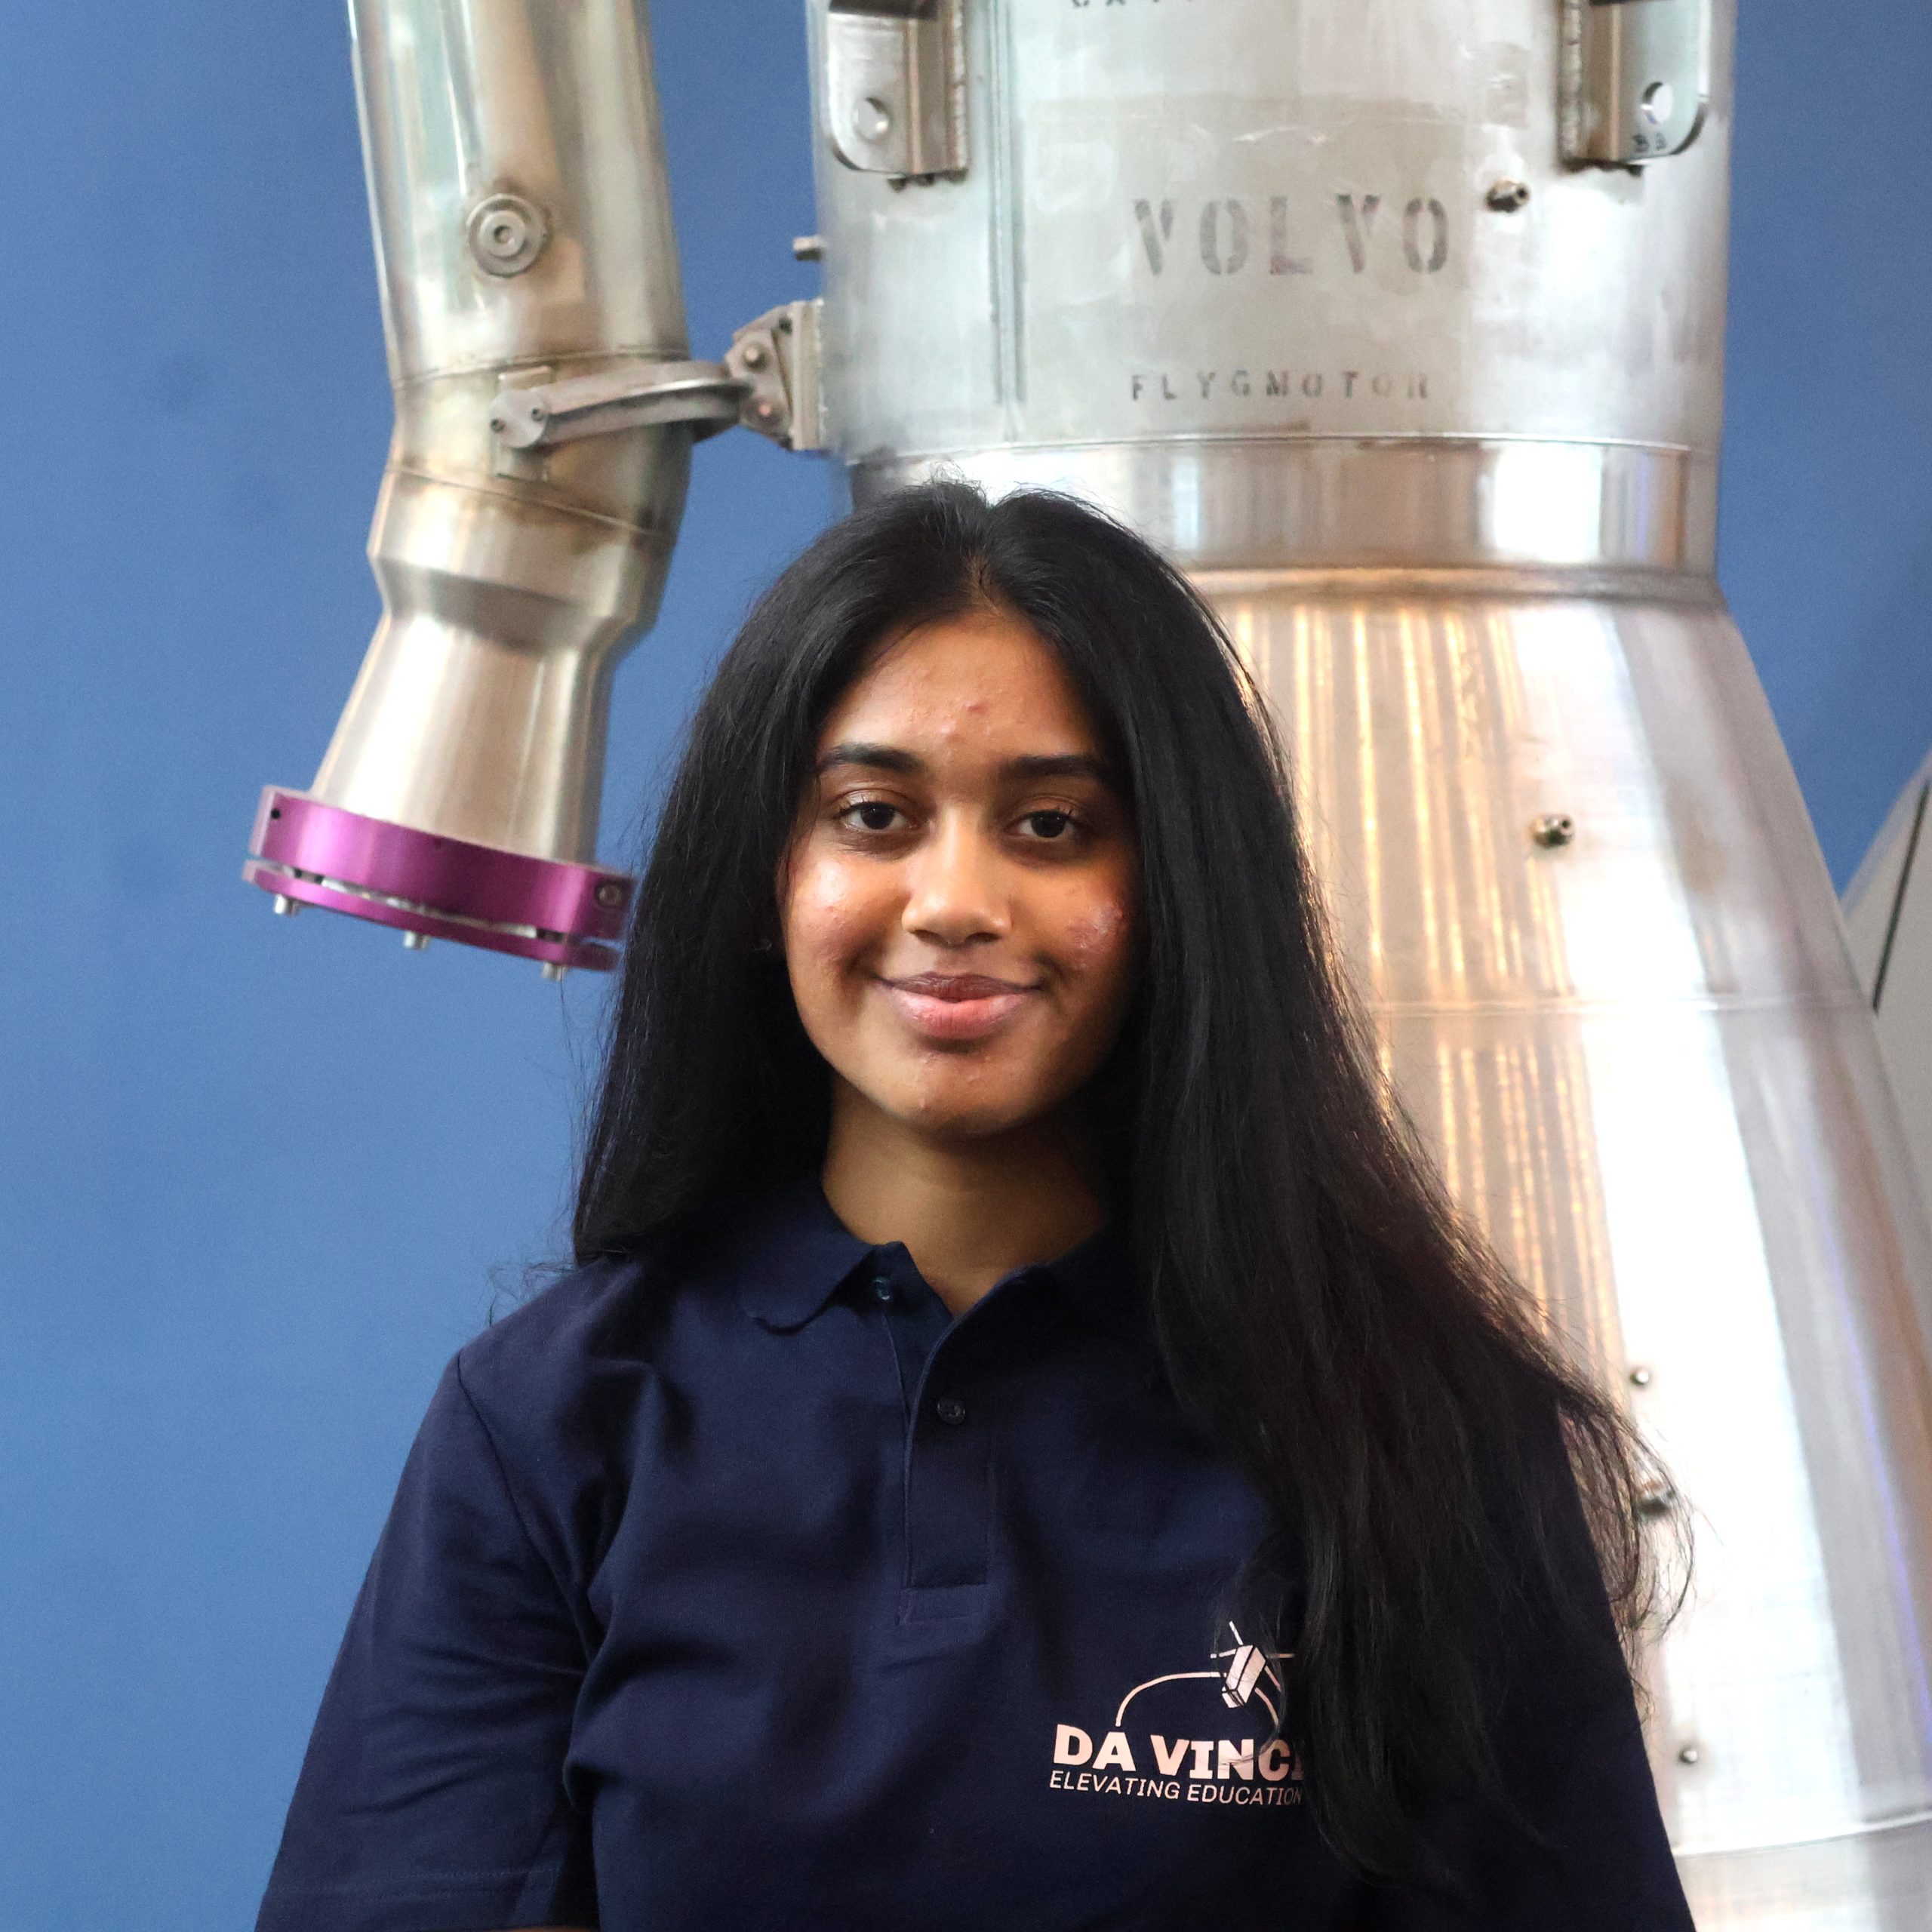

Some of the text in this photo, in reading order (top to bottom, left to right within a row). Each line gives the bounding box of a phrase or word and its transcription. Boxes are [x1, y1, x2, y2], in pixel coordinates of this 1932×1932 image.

[1134, 194, 1449, 275] VOLVO
[1053, 1724, 1137, 1772] DA
[1050, 1770, 1303, 1805] ELEVATING EDUCATION
